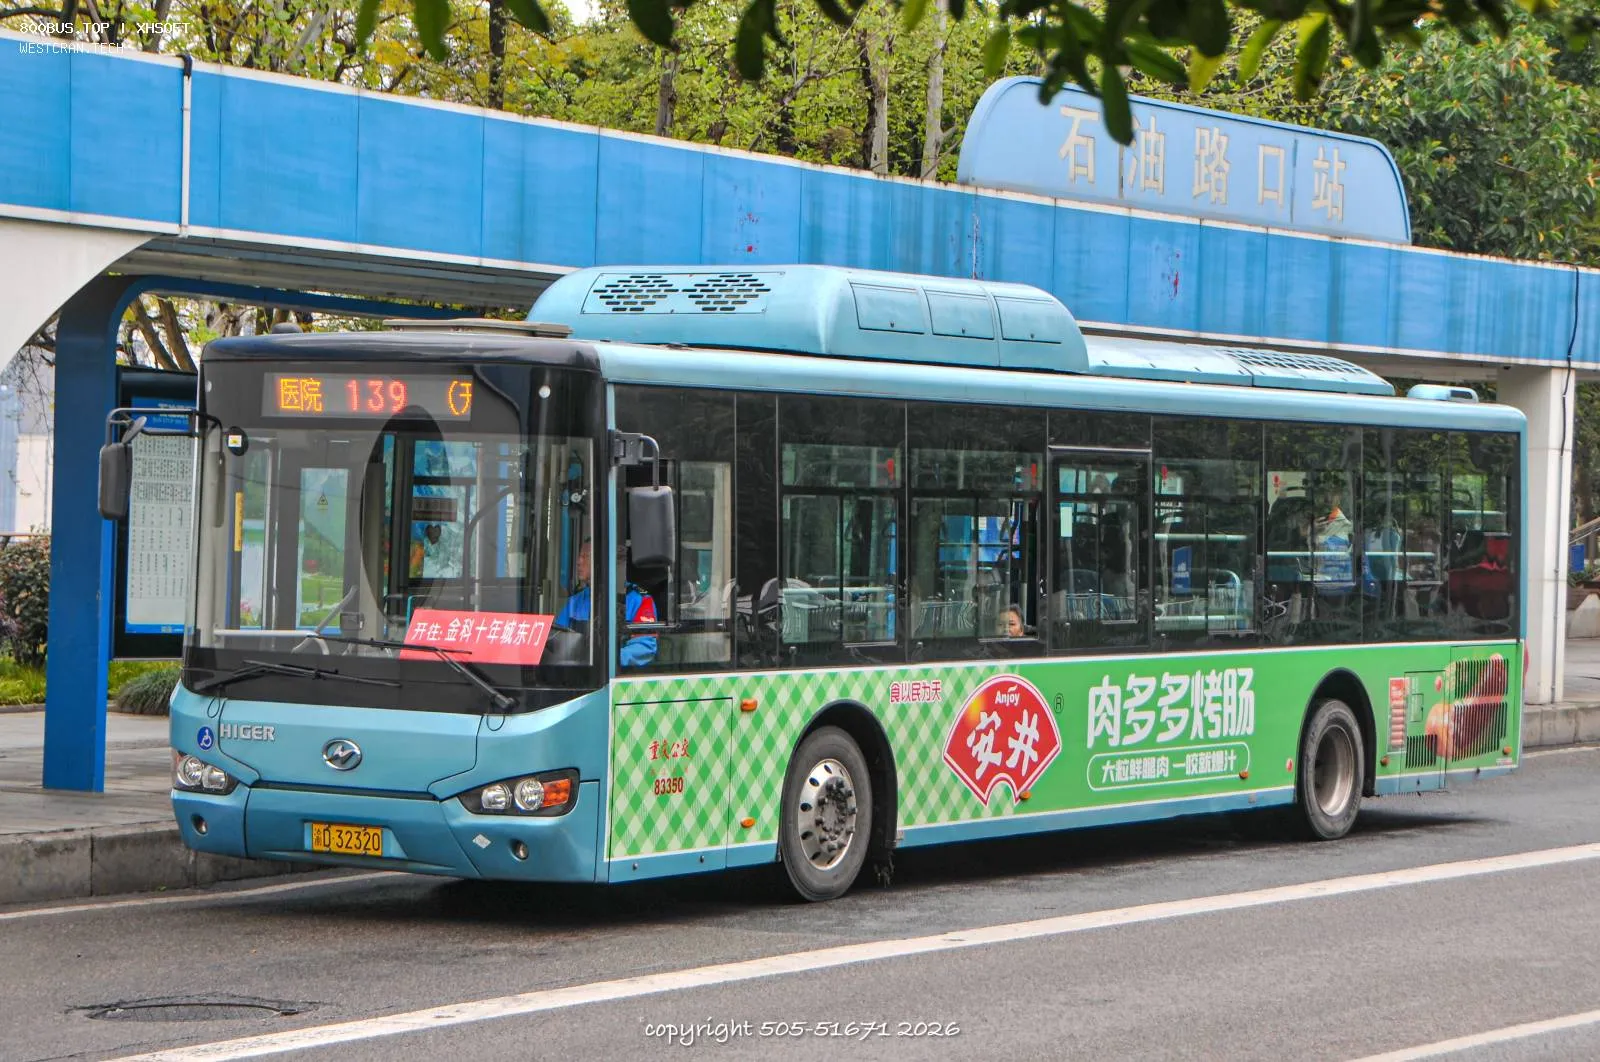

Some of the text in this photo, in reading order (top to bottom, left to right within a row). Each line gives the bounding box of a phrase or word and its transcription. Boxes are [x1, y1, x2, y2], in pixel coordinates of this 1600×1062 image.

[1059, 105, 1346, 223] 石油路口站
[279, 378, 323, 412] 医院
[347, 379, 408, 412] 139
[889, 680, 942, 704] 食以民为天
[994, 686, 1021, 707] Anjoy
[1087, 667, 1255, 749] 肉多多烤肠
[219, 723, 275, 742] HIGER
[966, 709, 1040, 780] 安井
[654, 777, 684, 796] 83350
